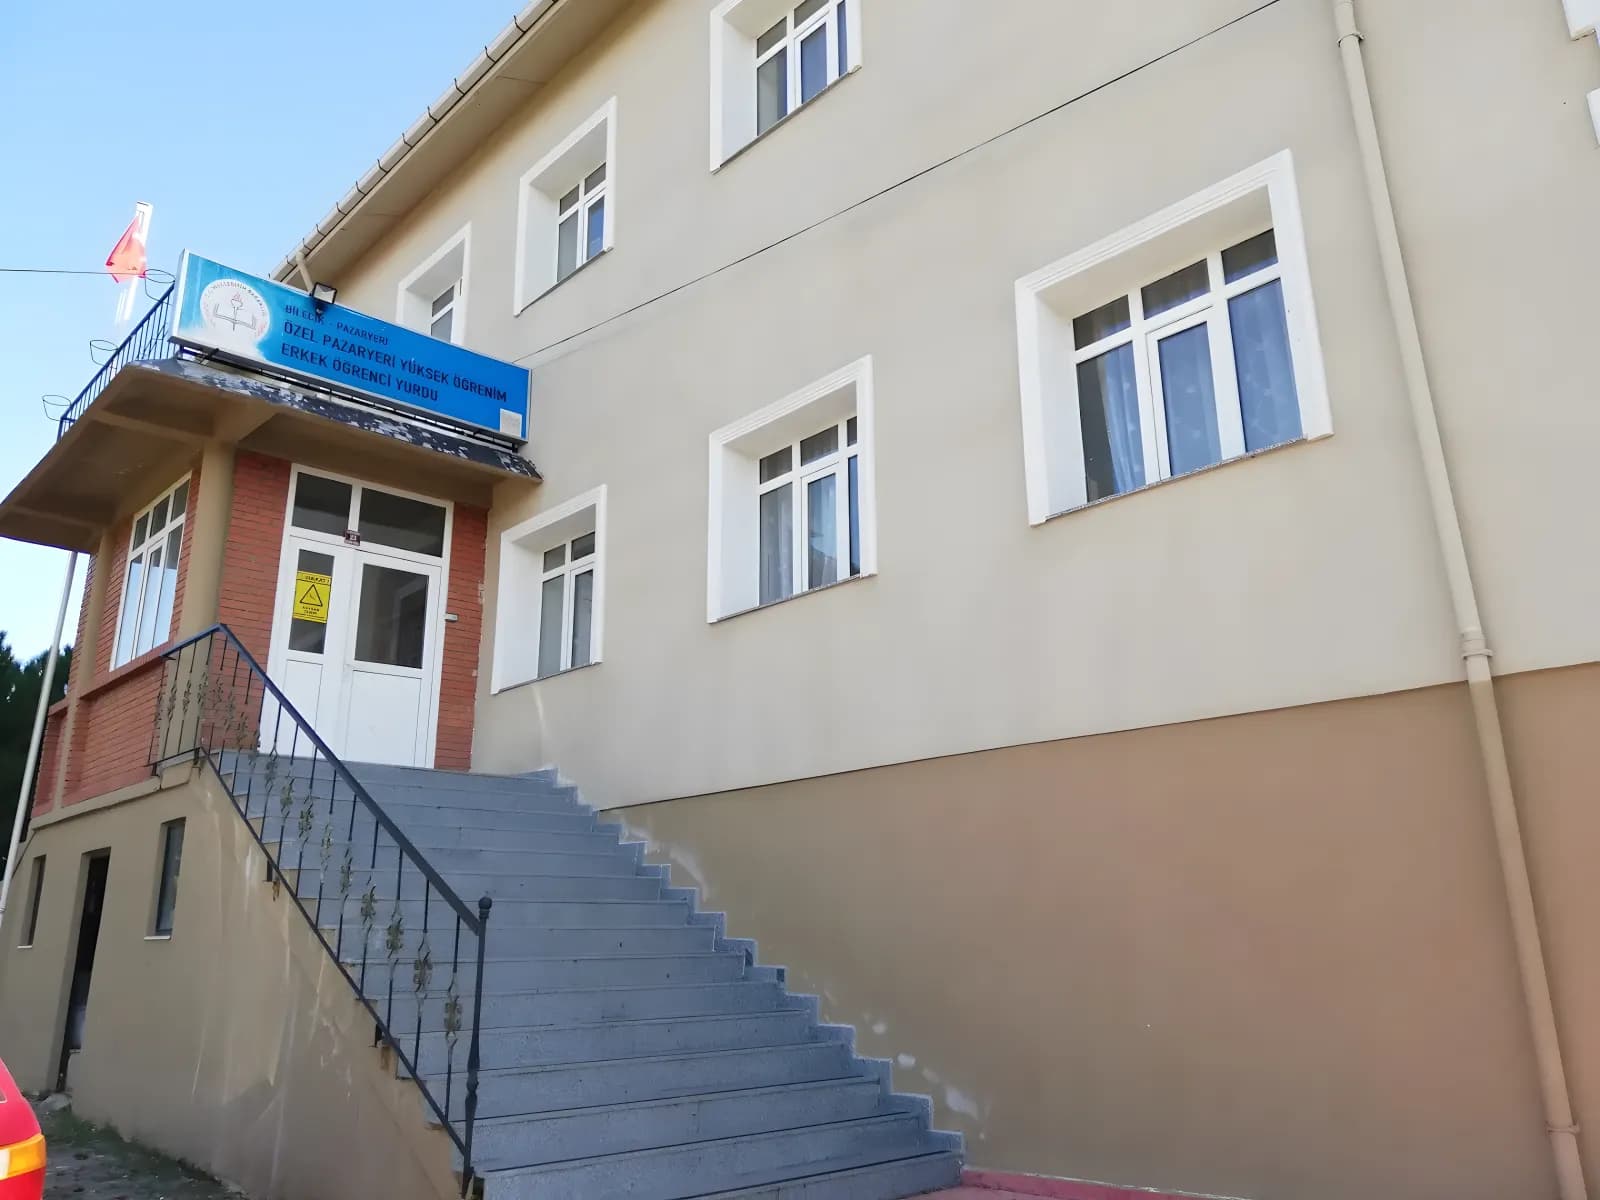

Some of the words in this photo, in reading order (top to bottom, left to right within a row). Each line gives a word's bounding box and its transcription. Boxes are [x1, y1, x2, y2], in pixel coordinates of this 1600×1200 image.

[281, 342, 328, 368] ERKEK
[332, 358, 391, 387] ÖĞRENCİ
[396, 379, 438, 401] YURDU
[284, 320, 319, 344] ÖZEL
[322, 334, 396, 368] PAZARYERİ
[400, 358, 449, 385] YÜKSEK
[453, 373, 507, 402] ÖĞRENİM
